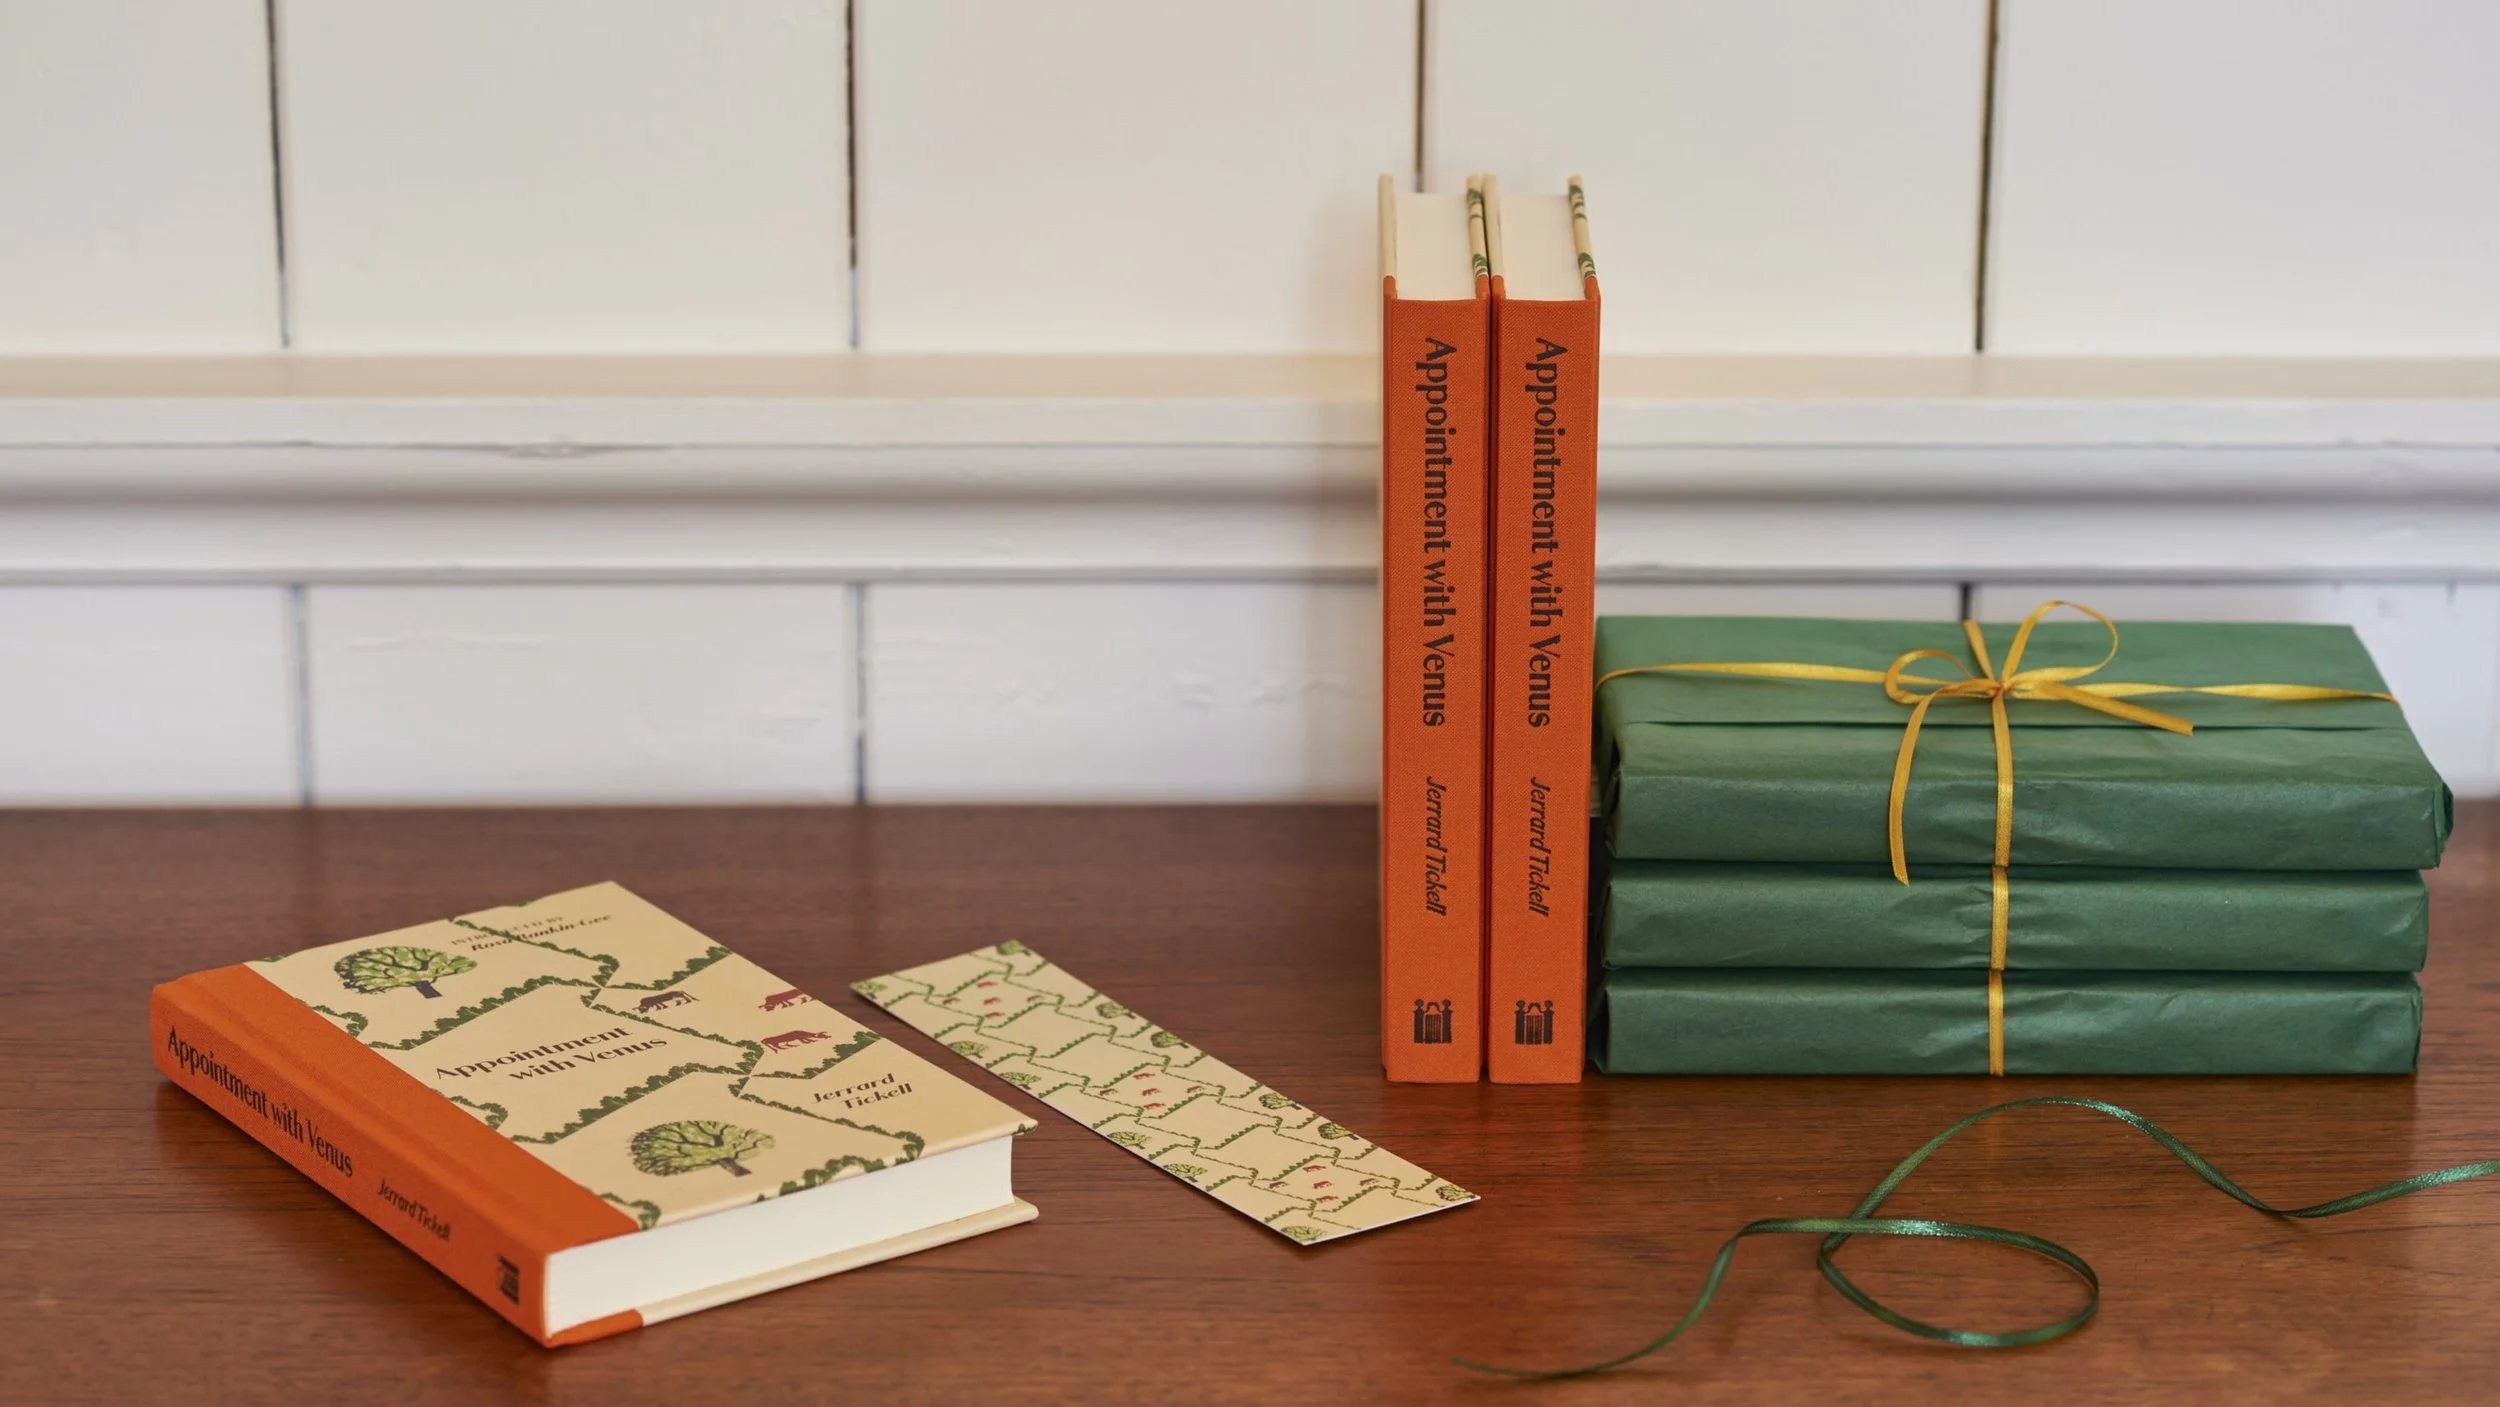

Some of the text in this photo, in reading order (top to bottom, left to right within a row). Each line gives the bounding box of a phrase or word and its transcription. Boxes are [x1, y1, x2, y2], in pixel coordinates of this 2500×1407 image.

[1415, 337, 1457, 728] Appointment with Venus
[1525, 337, 1568, 728] Appointment with Venus
[1425, 776, 1447, 916] Jerrard Tickell
[1528, 777, 1550, 917] Jerrard Tickell
[168, 1026, 353, 1177] Appointment with Venus
[436, 1027, 633, 1080] Appointment
[508, 1038, 668, 1081] with Venus
[811, 1073, 895, 1104] Jerrard
[840, 1083, 913, 1109] Tickell
[378, 1180, 451, 1241] Jerrard Tickell
